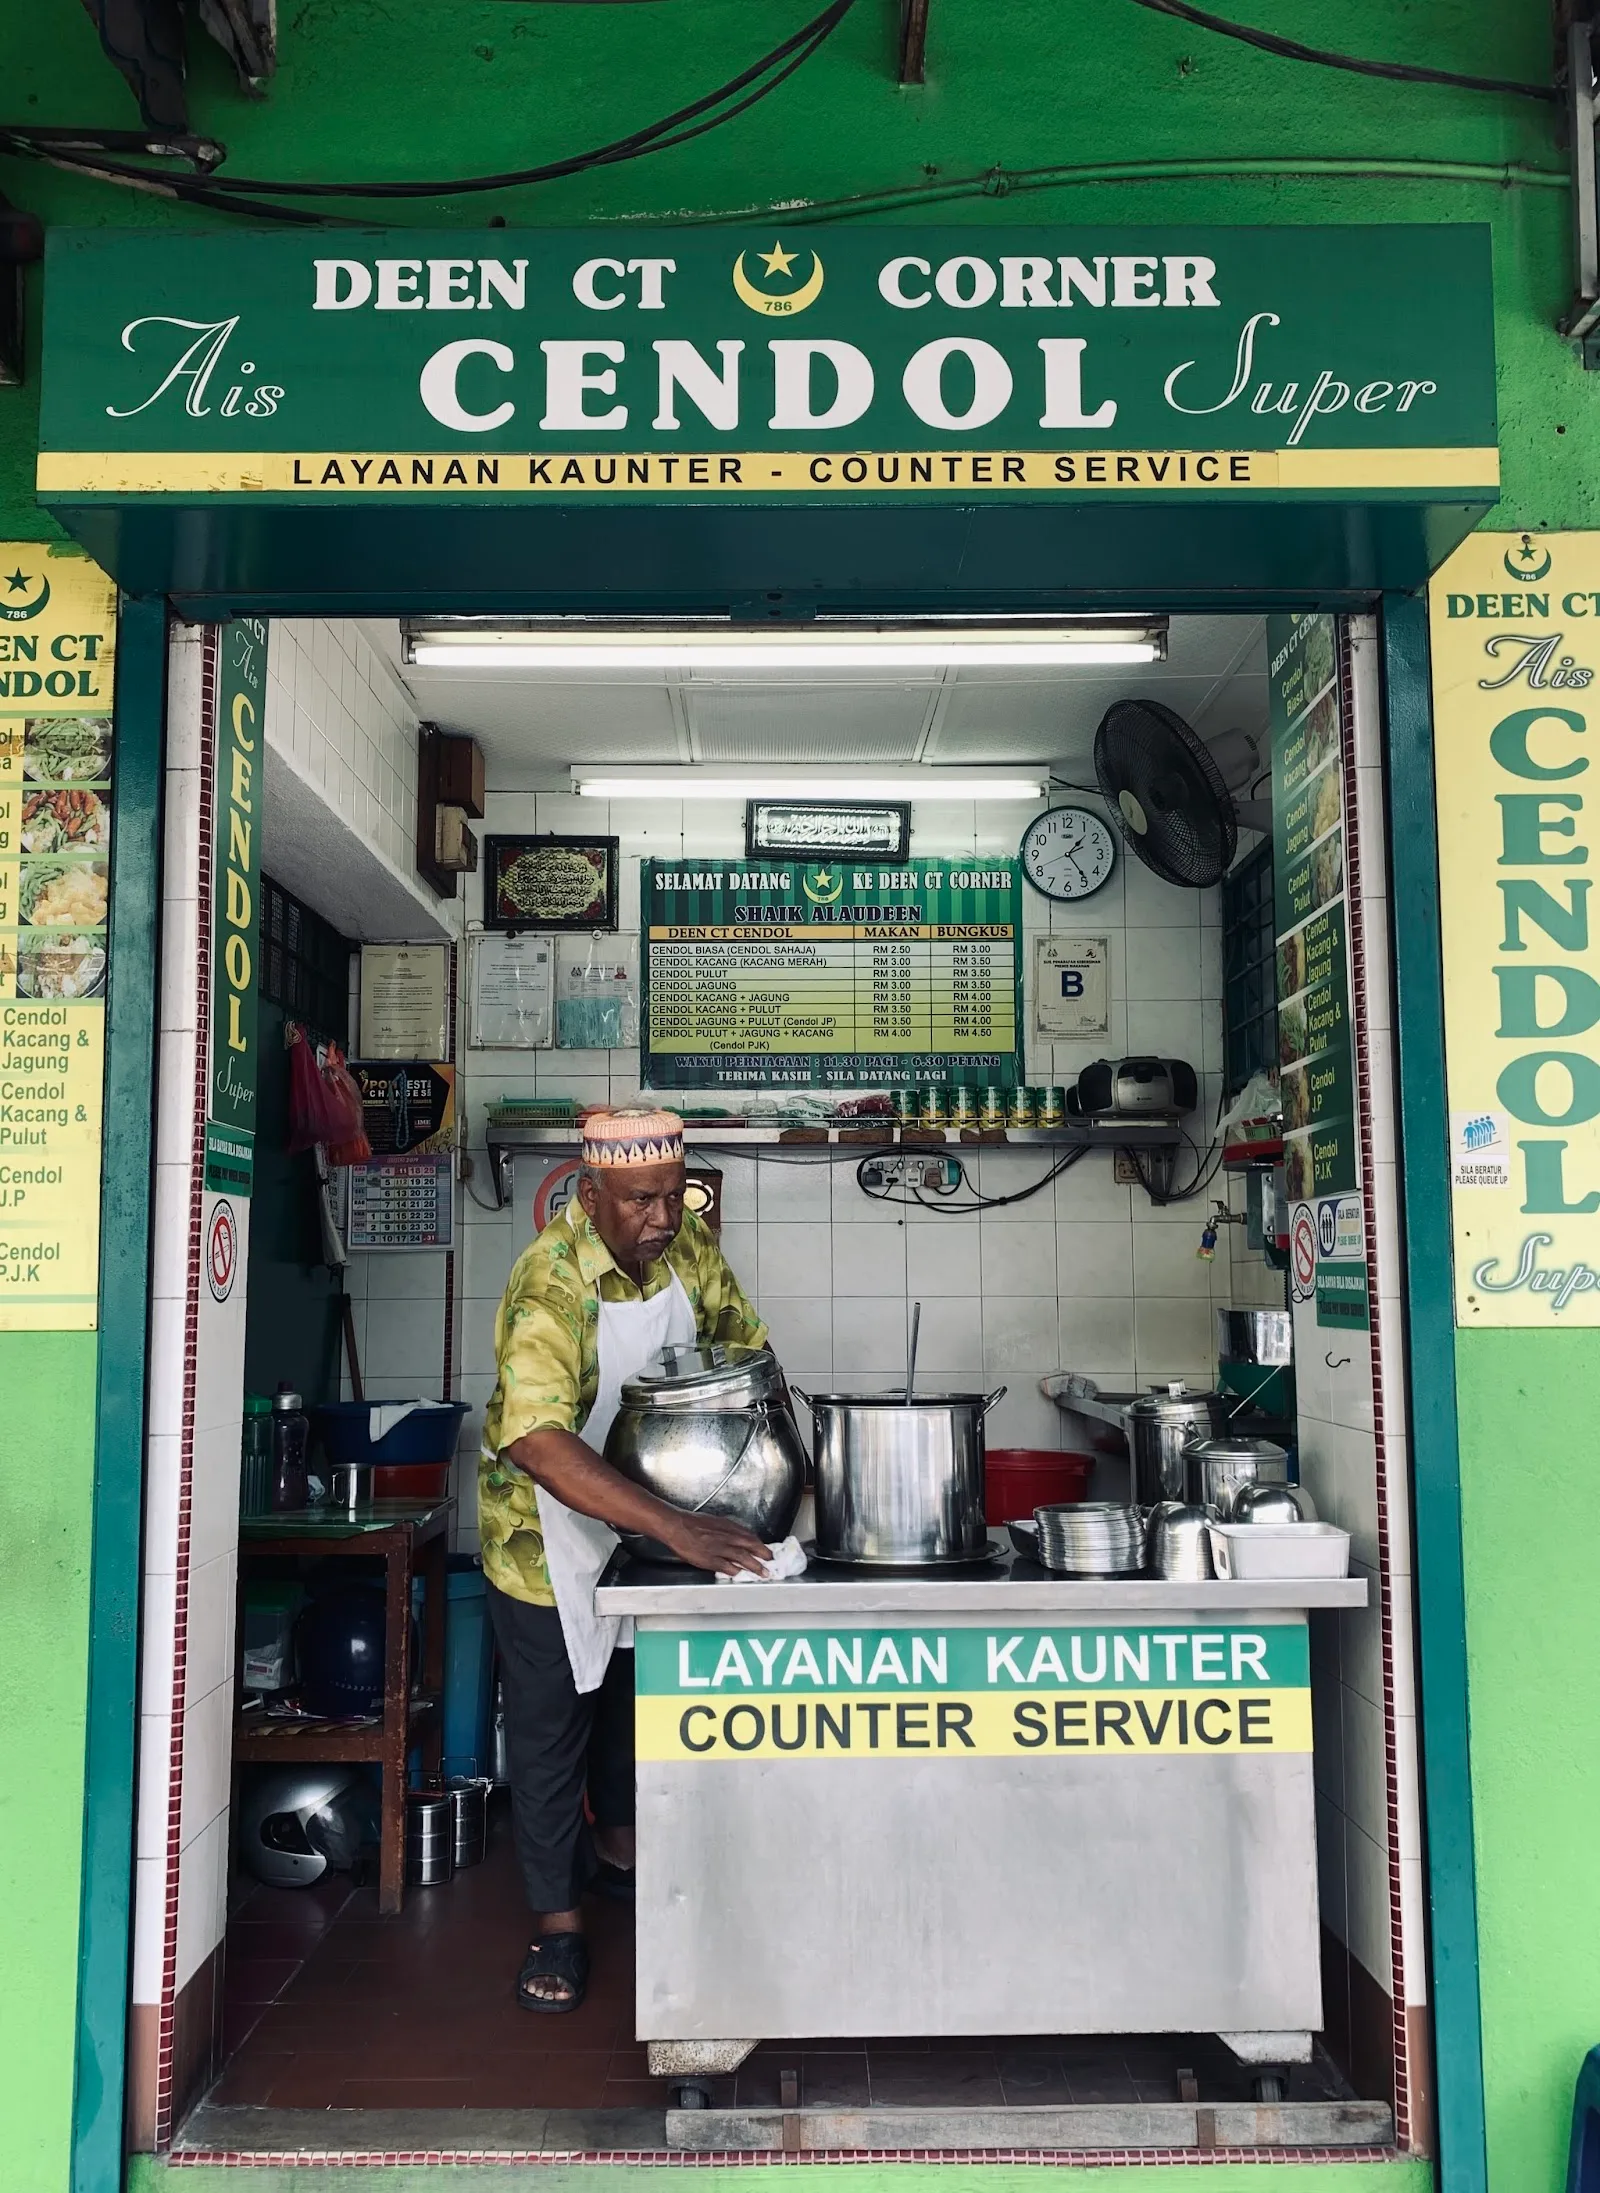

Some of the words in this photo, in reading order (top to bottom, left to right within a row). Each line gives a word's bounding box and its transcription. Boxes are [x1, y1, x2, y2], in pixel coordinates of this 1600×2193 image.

[312, 258, 530, 311] DEEN
[571, 258, 678, 311] CT
[877, 255, 1221, 310] CORNER
[763, 300, 794, 312] 786
[105, 314, 287, 420] Ais
[419, 336, 1118, 432] CENDOL
[1163, 312, 1438, 445] Super
[293, 457, 501, 485] LAYANAN
[529, 457, 745, 484] KAUNTER
[808, 456, 1028, 483] COUNTER
[1053, 454, 1253, 483] SERVICE
[1520, 573, 1537, 581] 786
[6, 610, 28, 619] 786
[1446, 593, 1550, 619] DEEN
[254, 618, 266, 646] CT
[50, 634, 104, 662] CT
[1271, 643, 1289, 679] DEEN
[1288, 630, 1298, 654] CT
[232, 630, 258, 689] Ais
[1478, 633, 1594, 689] Ais
[1281, 660, 1303, 699] Cendol
[1286, 688, 1304, 718] Biasa
[1284, 730, 1306, 765] Cendol
[1283, 759, 1306, 792] Kacang
[1286, 796, 1308, 830] Cendol
[1048, 822, 1056, 833] 11
[1062, 817, 1073, 828] 12
[1035, 834, 1046, 845] 10
[1091, 833, 1099, 844] 2
[1285, 825, 1308, 854] Jagung
[1031, 850, 1039, 861] 9
[1096, 849, 1104, 860] 3
[225, 691, 255, 1054] CENDOL
[1036, 865, 1043, 876] 8
[1092, 865, 1099, 876] 4
[1287, 864, 1310, 895] Cendol
[655, 872, 724, 890] SELAMAT
[729, 872, 791, 890] DATANG
[852, 872, 873, 890] KE
[878, 872, 919, 890] DEEN
[924, 871, 944, 889] CT
[949, 871, 1012, 889] CORNER
[1048, 877, 1055, 888] 7
[1064, 881, 1071, 892] 6
[1080, 876, 1088, 888] 5
[1294, 891, 1311, 914] Pulut
[735, 905, 804, 922] SHAIK
[810, 905, 922, 922] ALAUDEEN
[668, 928, 706, 938] DEEN
[710, 928, 730, 938] CT
[733, 928, 793, 938] CENDOL
[864, 927, 920, 937] MAKAN
[937, 926, 1009, 937] BUNGKUS
[1306, 912, 1329, 942] Cendol
[652, 946, 693, 955] CENDOL
[696, 946, 725, 955] BIASA
[727, 946, 772, 956] (CENDOL
[774, 946, 816, 956] SAHAJA)
[873, 946, 888, 954] RM
[891, 946, 911, 954] 2.50
[953, 946, 968, 954] RM
[971, 946, 991, 954] 3.00
[1306, 938, 1331, 963] Kacang
[1332, 929, 1338, 946] &
[652, 958, 693, 966] CENDOL
[696, 958, 737, 966] KACANG
[740, 958, 785, 968] (KACANG
[788, 958, 827, 967] MERAH)
[873, 958, 888, 966] RM
[891, 958, 911, 966] 3.00
[1489, 706, 1600, 1214] CENDOL
[652, 970, 693, 978] CENDOL
[696, 970, 728, 978] PULUT
[1307, 958, 1332, 983] Jagung
[652, 982, 693, 990] CENDOL
[695, 982, 737, 990] JAGUNG
[1062, 970, 1084, 997] B
[652, 994, 693, 1002] CENDOL
[696, 994, 737, 1002] KACANG
[748, 994, 790, 1002] JAGUNG
[1308, 984, 1332, 1011] Cendol
[4, 1007, 67, 1026] Cendol
[652, 1005, 693, 1014] CENDOL
[696, 1005, 737, 1014] KACANG
[749, 1005, 781, 1014] PULUT
[1308, 1009, 1334, 1033] Kacang
[1335, 1002, 1341, 1020] &
[652, 1017, 693, 1026] CENDOL
[695, 1017, 737, 1026] JAGUNG
[748, 1017, 781, 1026] PULUT
[783, 1017, 818, 1027] (Cendol
[821, 1017, 836, 1027] JP)
[2, 1030, 70, 1052] Kacang
[77, 1030, 89, 1047] &
[652, 1030, 693, 1038] CENDOL
[696, 1030, 728, 1038] PULUT
[739, 1030, 780, 1038] JAGUNG
[792, 1030, 834, 1038] KACANG
[1309, 1031, 1327, 1054] Pulut
[710, 1041, 745, 1050] (Cendol
[748, 1041, 770, 1050] PJK)
[1, 1052, 69, 1073] Jagung
[675, 1056, 722, 1067] WAKTU
[725, 1056, 811, 1067] PERNIAGAAN
[823, 1056, 860, 1067] 11.30
[864, 1056, 899, 1066] PAGI
[911, 1056, 945, 1066] 6.30
[947, 1056, 1000, 1066] PETANG
[216, 1055, 255, 1110] Super
[717, 1071, 767, 1081] TERIMA
[771, 1071, 812, 1081] KASIH
[826, 1071, 855, 1081] SILA
[859, 1071, 911, 1081] DATANG
[915, 1071, 947, 1080] LAGI
[1311, 1066, 1335, 1091] Cendol
[1, 1082, 65, 1100] Cendol
[1312, 1094, 1322, 1113] J.P
[0, 1105, 69, 1126] Kacang
[74, 1104, 87, 1122] &
[0, 1128, 47, 1145] Pulut
[1314, 1138, 1338, 1161] Cendol
[0, 1166, 62, 1184] Cendol
[1315, 1161, 1332, 1180] P.J.K
[1460, 1166, 1474, 1174] SILA
[1475, 1166, 1502, 1174] BERATUR
[1455, 1176, 1478, 1184] PLEASE
[1480, 1176, 1498, 1186] QUEUE
[1500, 1176, 1508, 1184] UP
[0, 1189, 26, 1207] J.P
[0, 1242, 60, 1260] Cendol
[0, 1264, 40, 1282] P.J.K
[678, 1636, 948, 1687] LAYANAN
[987, 1633, 1271, 1683] KAUNTER
[679, 1702, 974, 1752] COUNTER
[1013, 1697, 1274, 1747] SERVICE
